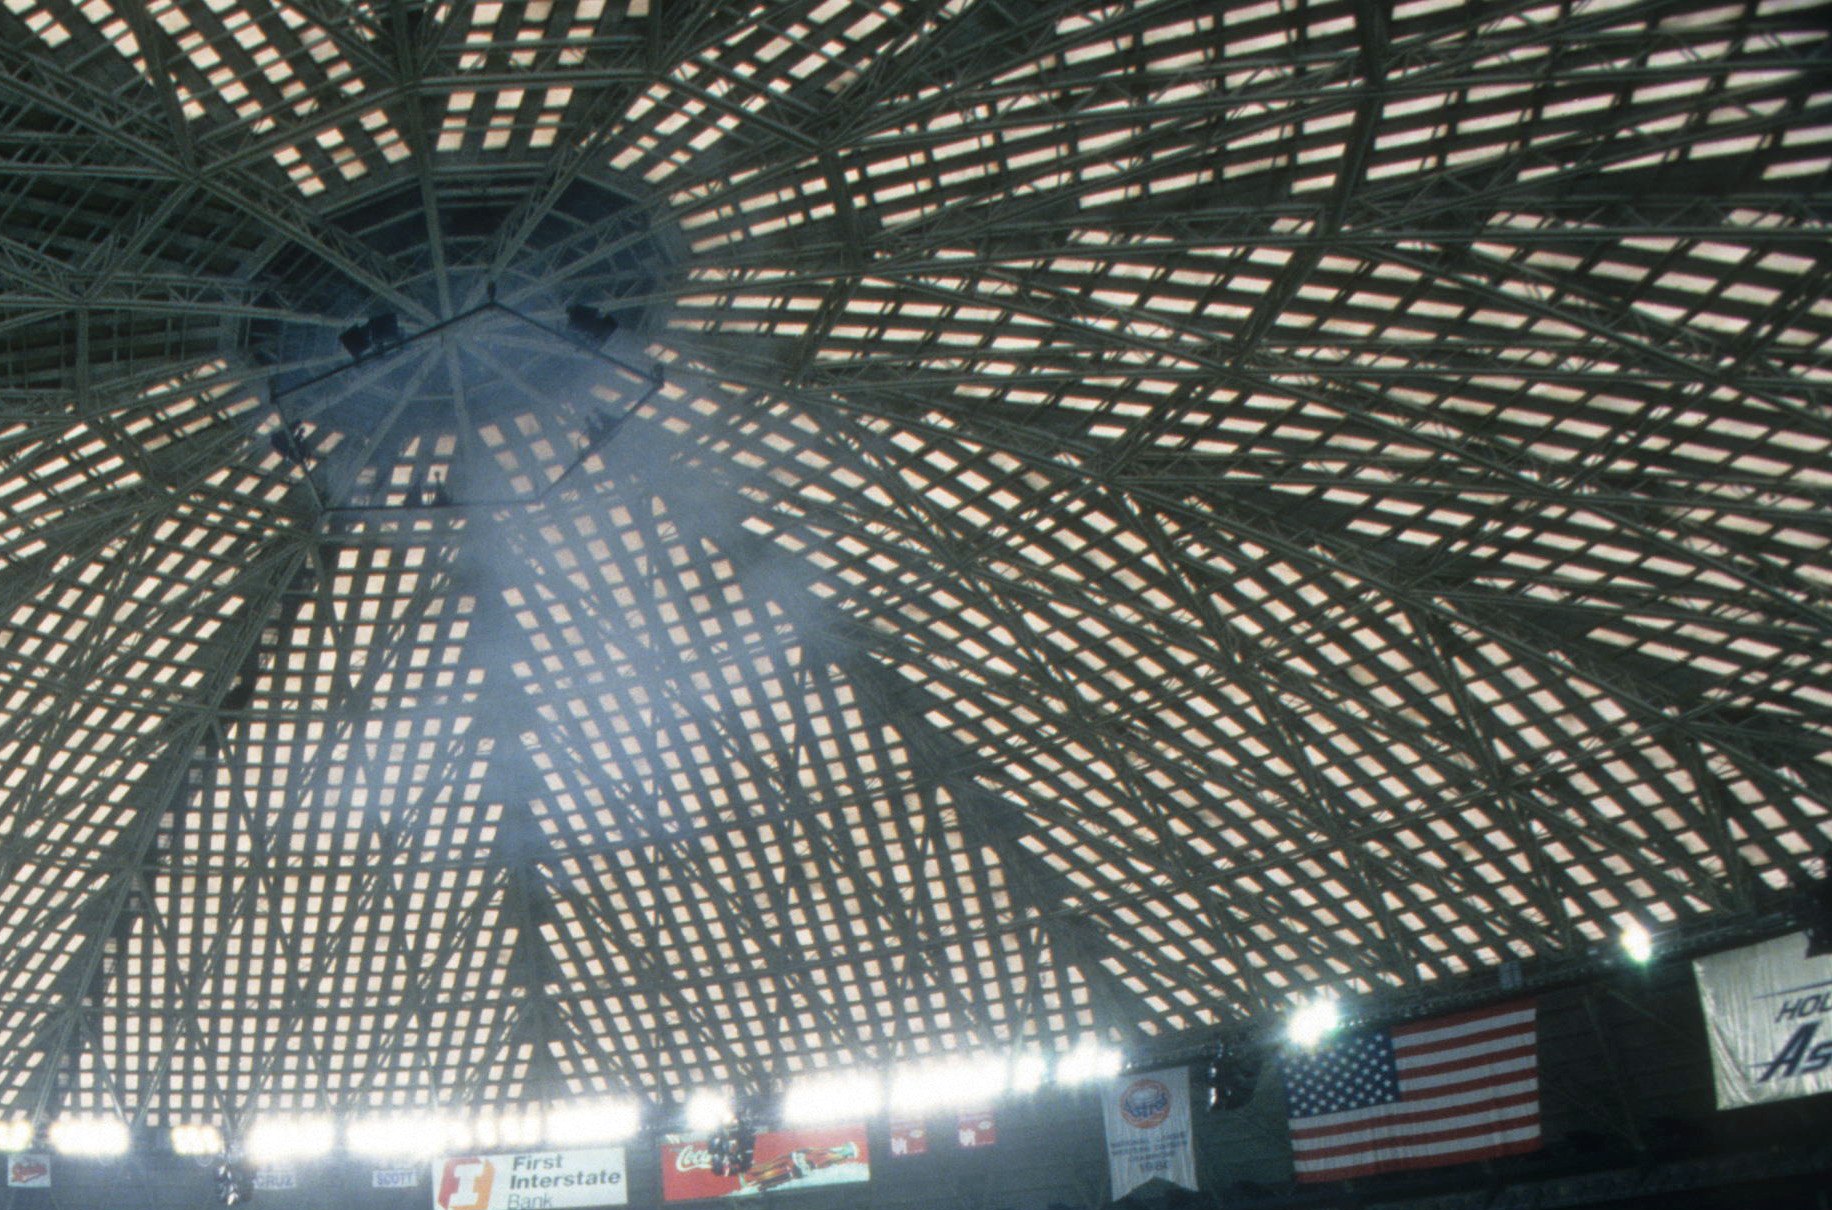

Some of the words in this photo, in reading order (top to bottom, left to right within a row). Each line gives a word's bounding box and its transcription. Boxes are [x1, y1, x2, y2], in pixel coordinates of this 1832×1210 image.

[512, 1153, 565, 1172] First
[376, 1171, 414, 1186] SCOTT
[509, 1170, 622, 1191] Interstate
[507, 1192, 553, 1210] Bank
